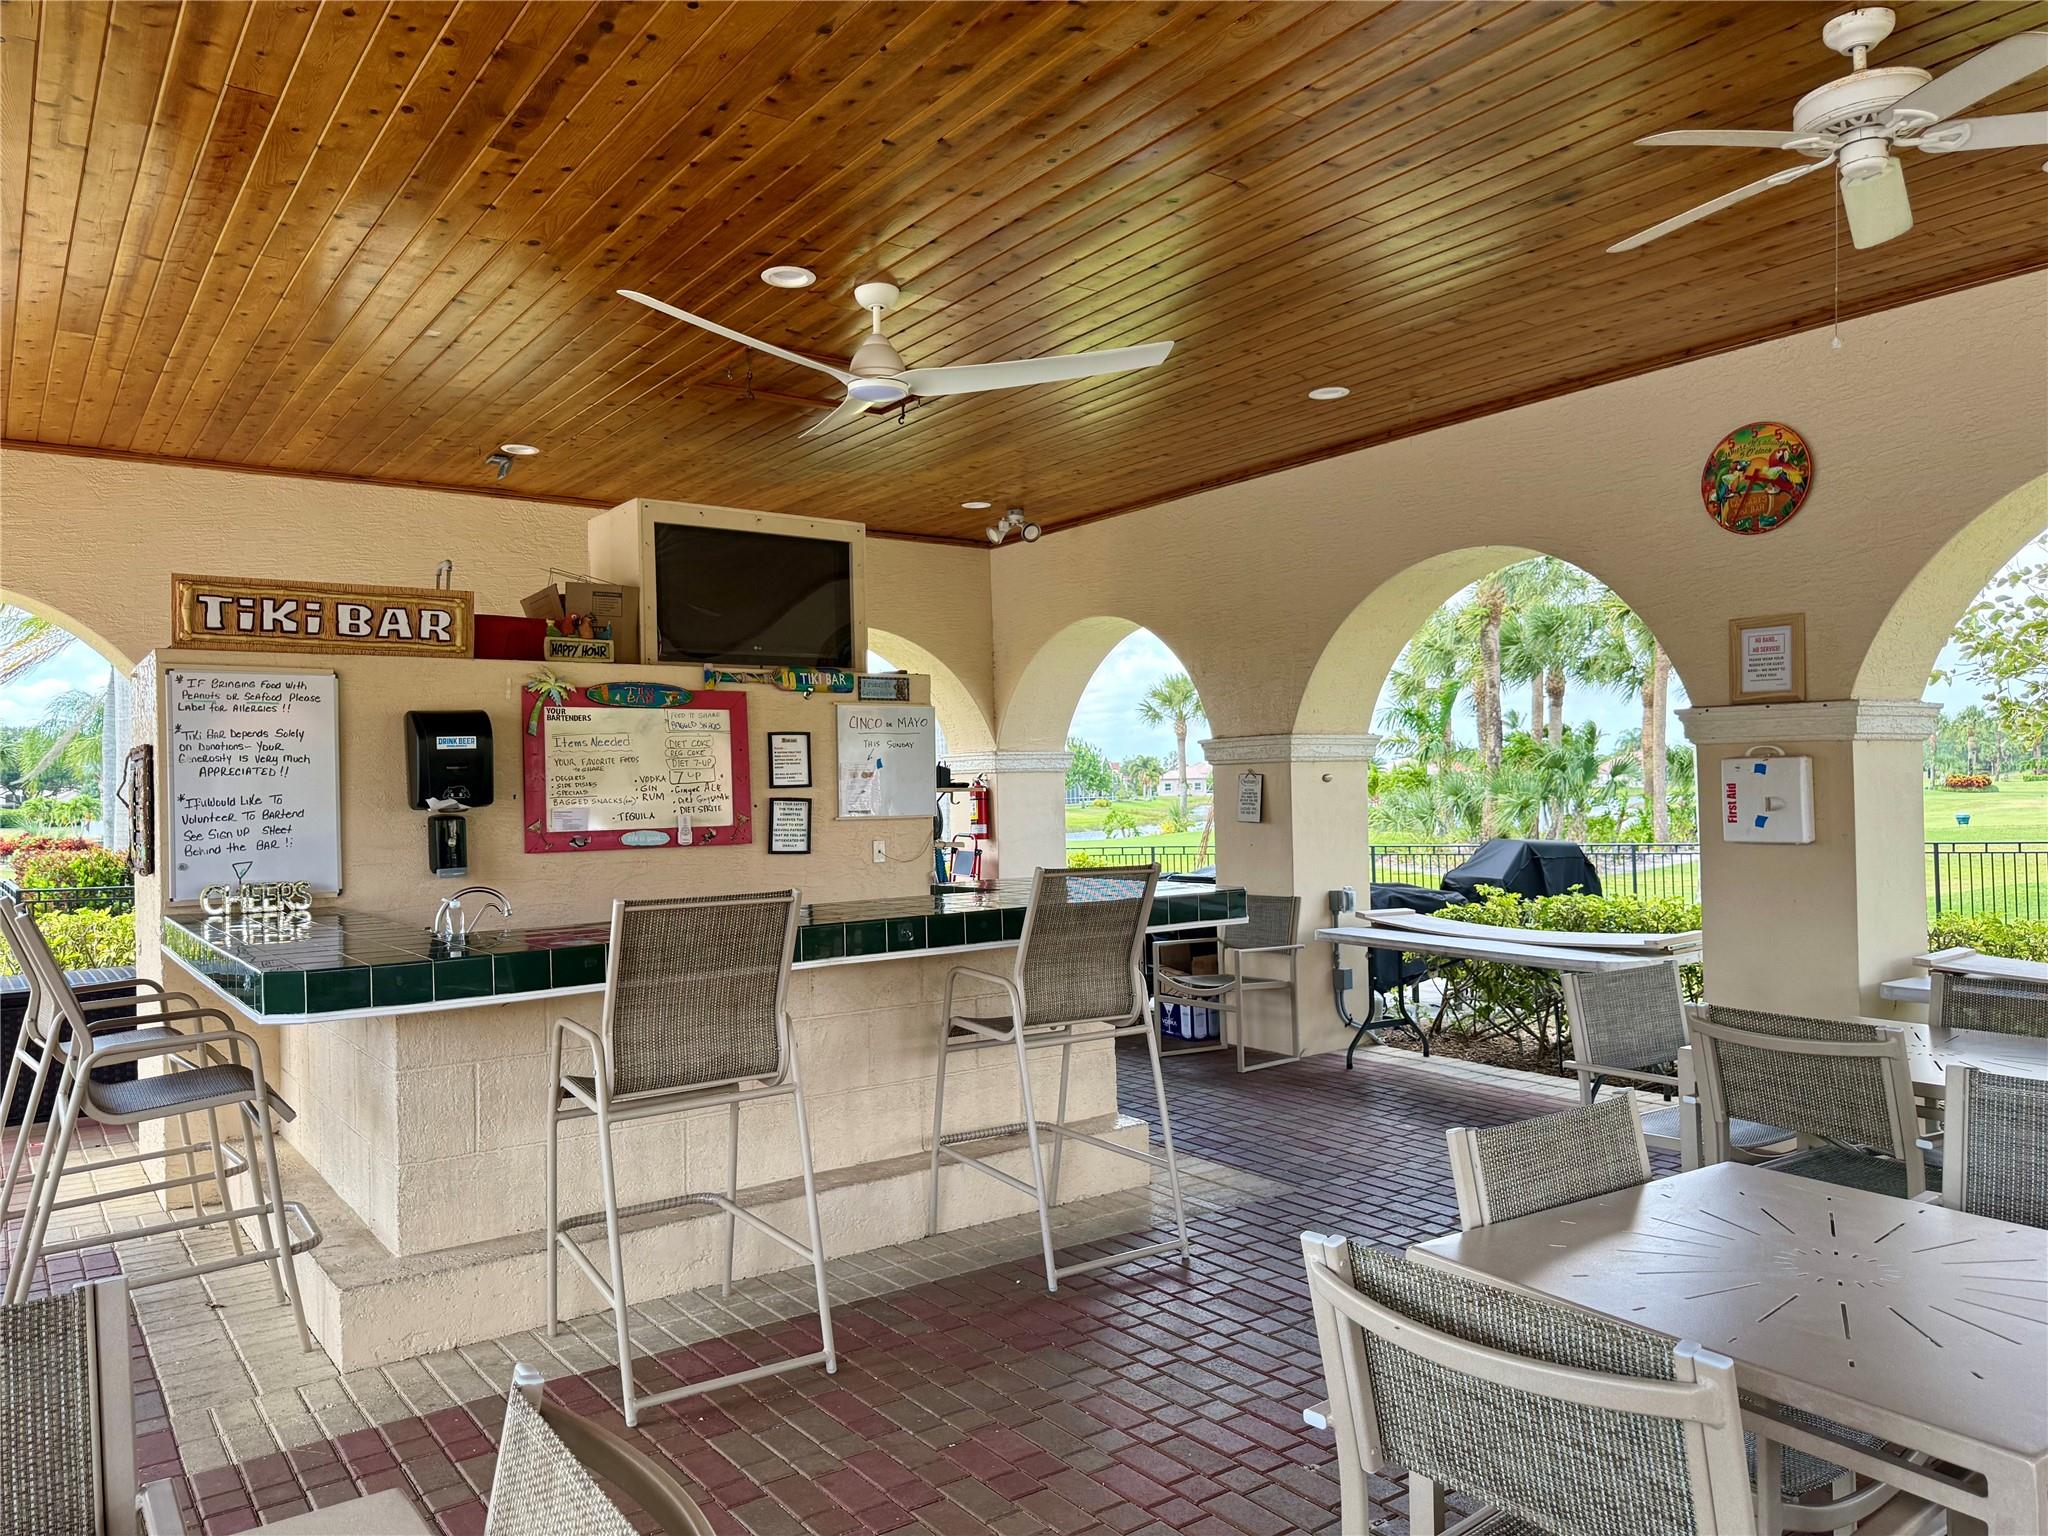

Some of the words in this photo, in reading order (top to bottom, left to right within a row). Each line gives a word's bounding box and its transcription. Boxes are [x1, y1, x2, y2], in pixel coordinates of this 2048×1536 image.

[1774, 428, 1782, 440] 5
[1728, 438, 1735, 449] 5
[336, 602, 453, 642] BAR
[551, 642, 579, 657] HAPPY
[581, 642, 607, 657] HOUR
[800, 672, 822, 685] TIKI
[825, 672, 847, 686] BAR
[546, 714, 592, 722] BARTENDERS
[848, 715, 883, 730] CINCO
[897, 716, 929, 730] MAYO
[438, 737, 458, 746] DRINK
[458, 736, 475, 745] BEER
[553, 736, 588, 748] Items
[590, 735, 631, 748] Needed
[864, 739, 880, 749] THIS
[886, 740, 914, 749] SUNDAY
[553, 757, 577, 767] YOUR
[581, 757, 616, 766] FAVORITE
[671, 759, 689, 768] DIET
[639, 775, 667, 783] VODKA
[673, 771, 684, 784] 7
[640, 784, 657, 792] GIN
[1726, 783, 1737, 800] Aid
[642, 793, 665, 801] RUM
[553, 799, 589, 807] BAGGED
[680, 806, 695, 815] DIET
[1727, 801, 1738, 824] First
[617, 811, 656, 822] TEQUILA
[256, 839, 280, 851] BAR
